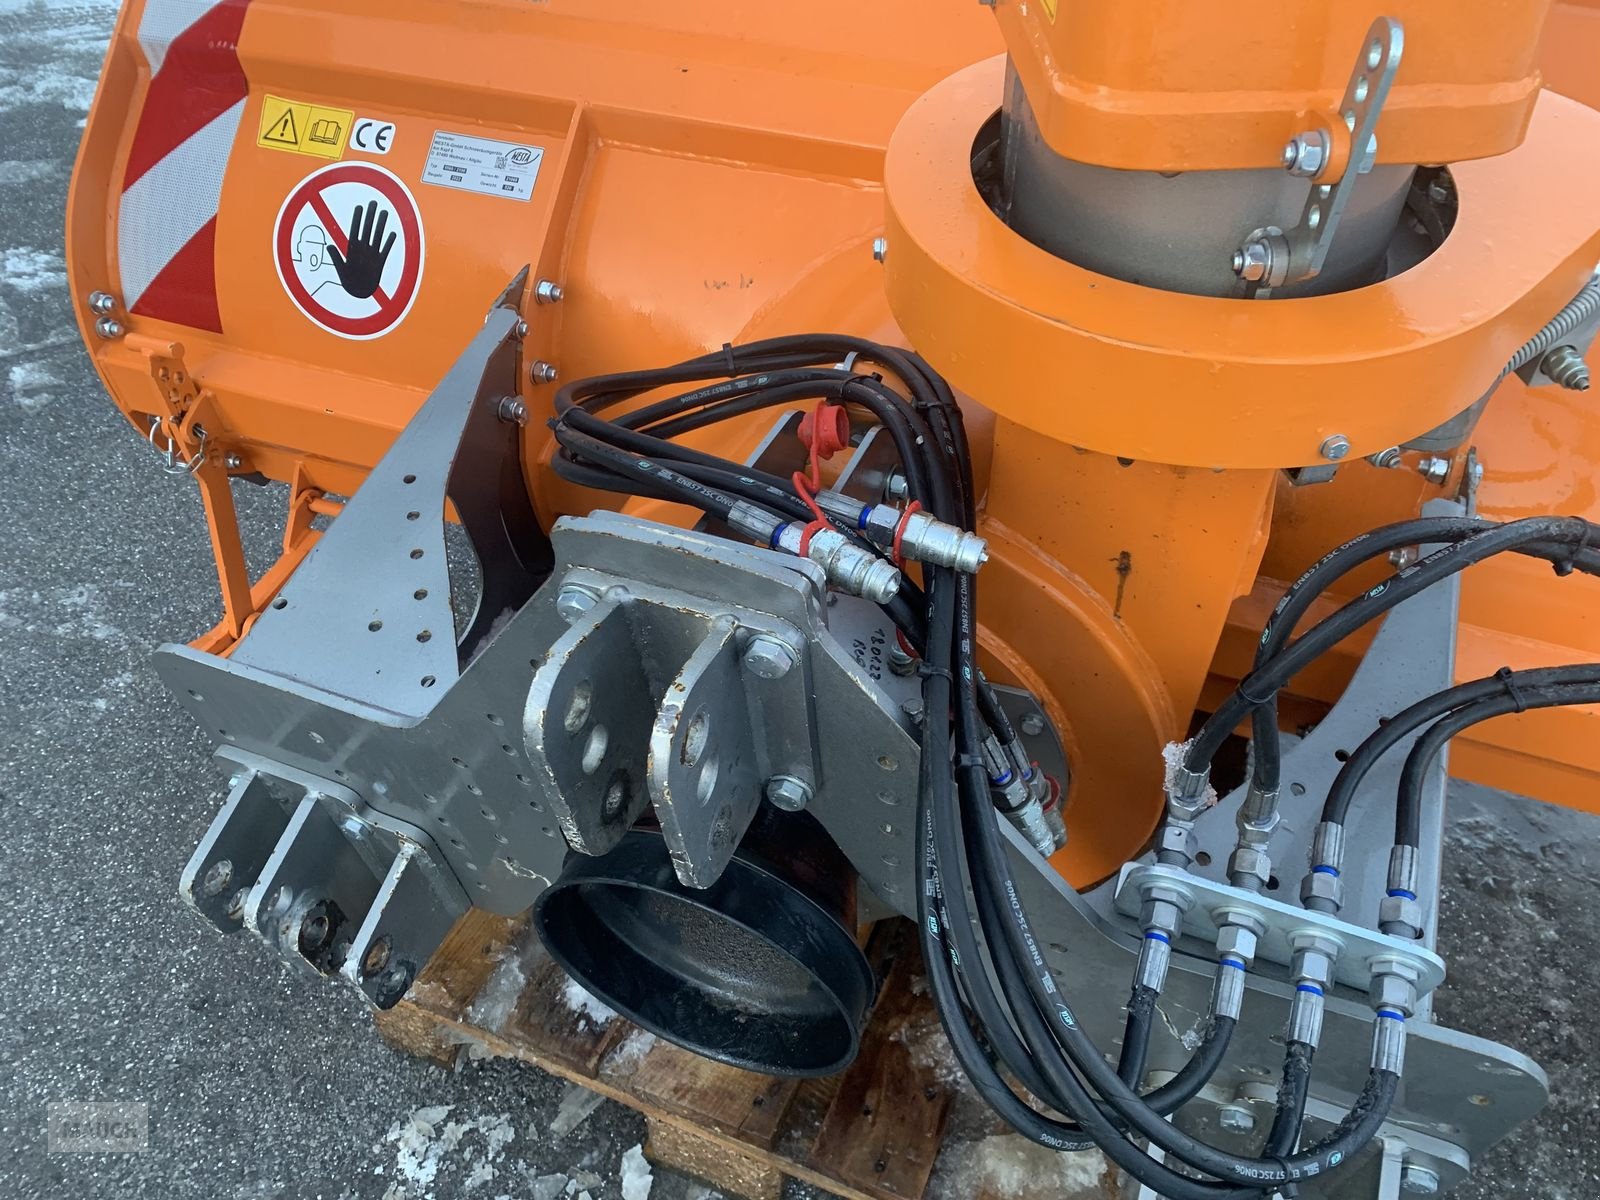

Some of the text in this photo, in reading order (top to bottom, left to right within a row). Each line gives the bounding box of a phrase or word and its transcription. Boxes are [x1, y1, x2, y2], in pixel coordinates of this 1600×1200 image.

[356, 122, 392, 151] CE
[511, 151, 531, 162] WESTA
[676, 477, 701, 493] EN857
[716, 495, 733, 507] DN0
[1292, 562, 1321, 591] EN857
[1340, 532, 1371, 551] DN06
[961, 574, 969, 594] DN06
[961, 609, 970, 634] EN857
[1004, 879, 1020, 909] DN06
[1014, 910, 1028, 931] 2SC
[1023, 932, 1043, 967] EN857
[1040, 1133, 1063, 1147] DN06
[1234, 1164, 1259, 1178] DN06
[1259, 1169, 1275, 1180] 2SC
